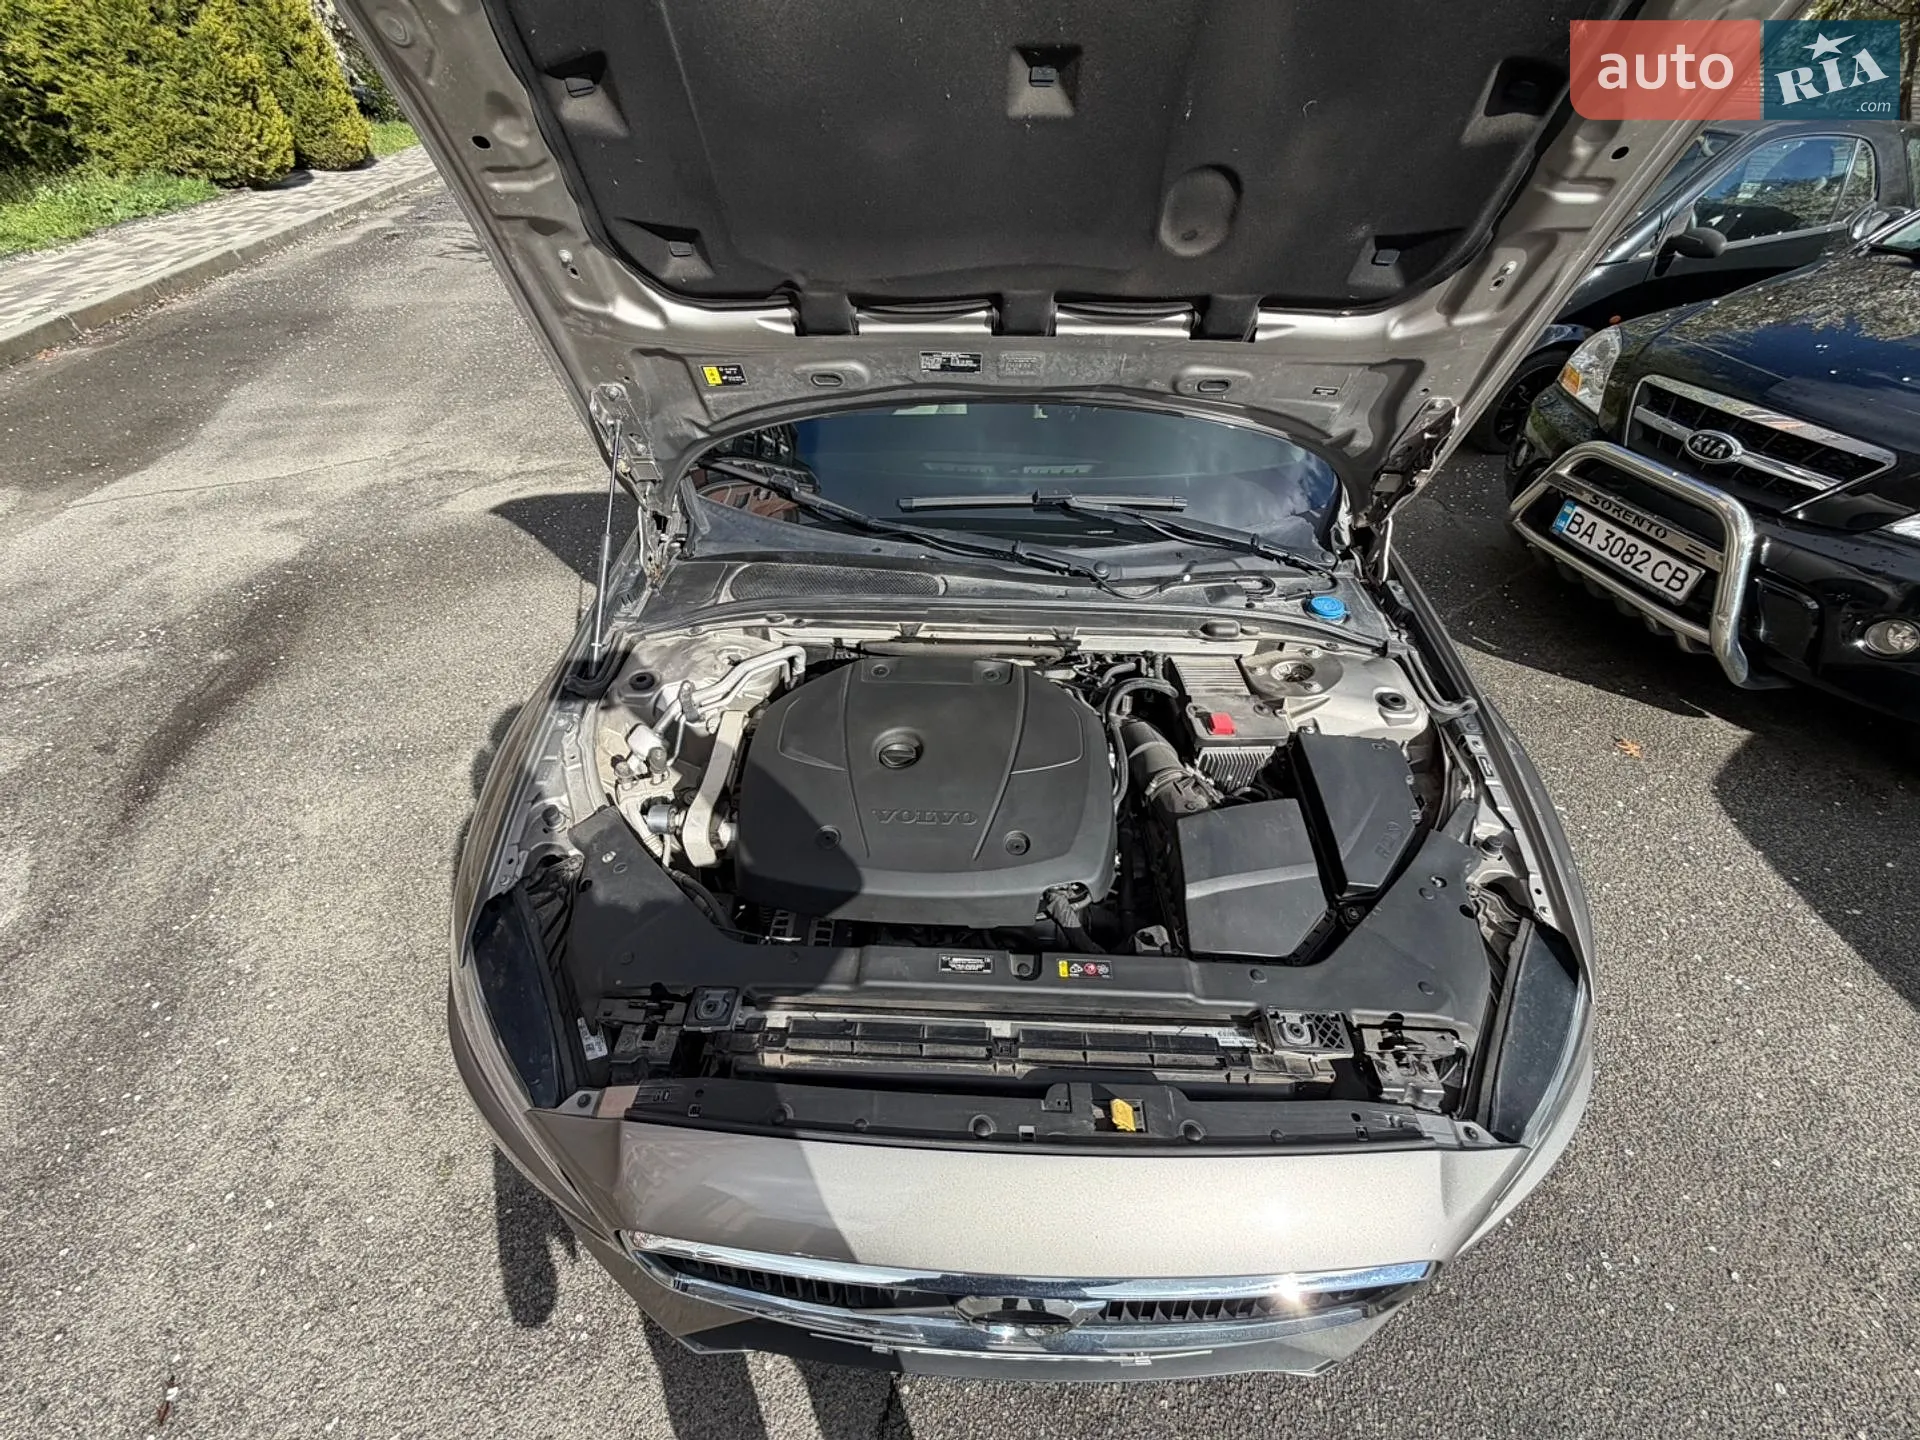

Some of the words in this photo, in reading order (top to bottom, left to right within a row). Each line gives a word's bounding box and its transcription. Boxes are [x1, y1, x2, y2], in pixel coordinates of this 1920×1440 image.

[1691, 436, 1727, 458] KIA
[1589, 494, 1668, 540] SORENTO
[1565, 511, 1598, 545] BA
[1597, 529, 1653, 574] 3082
[1650, 560, 1690, 593] CB
[874, 808, 979, 825] VOLVO
